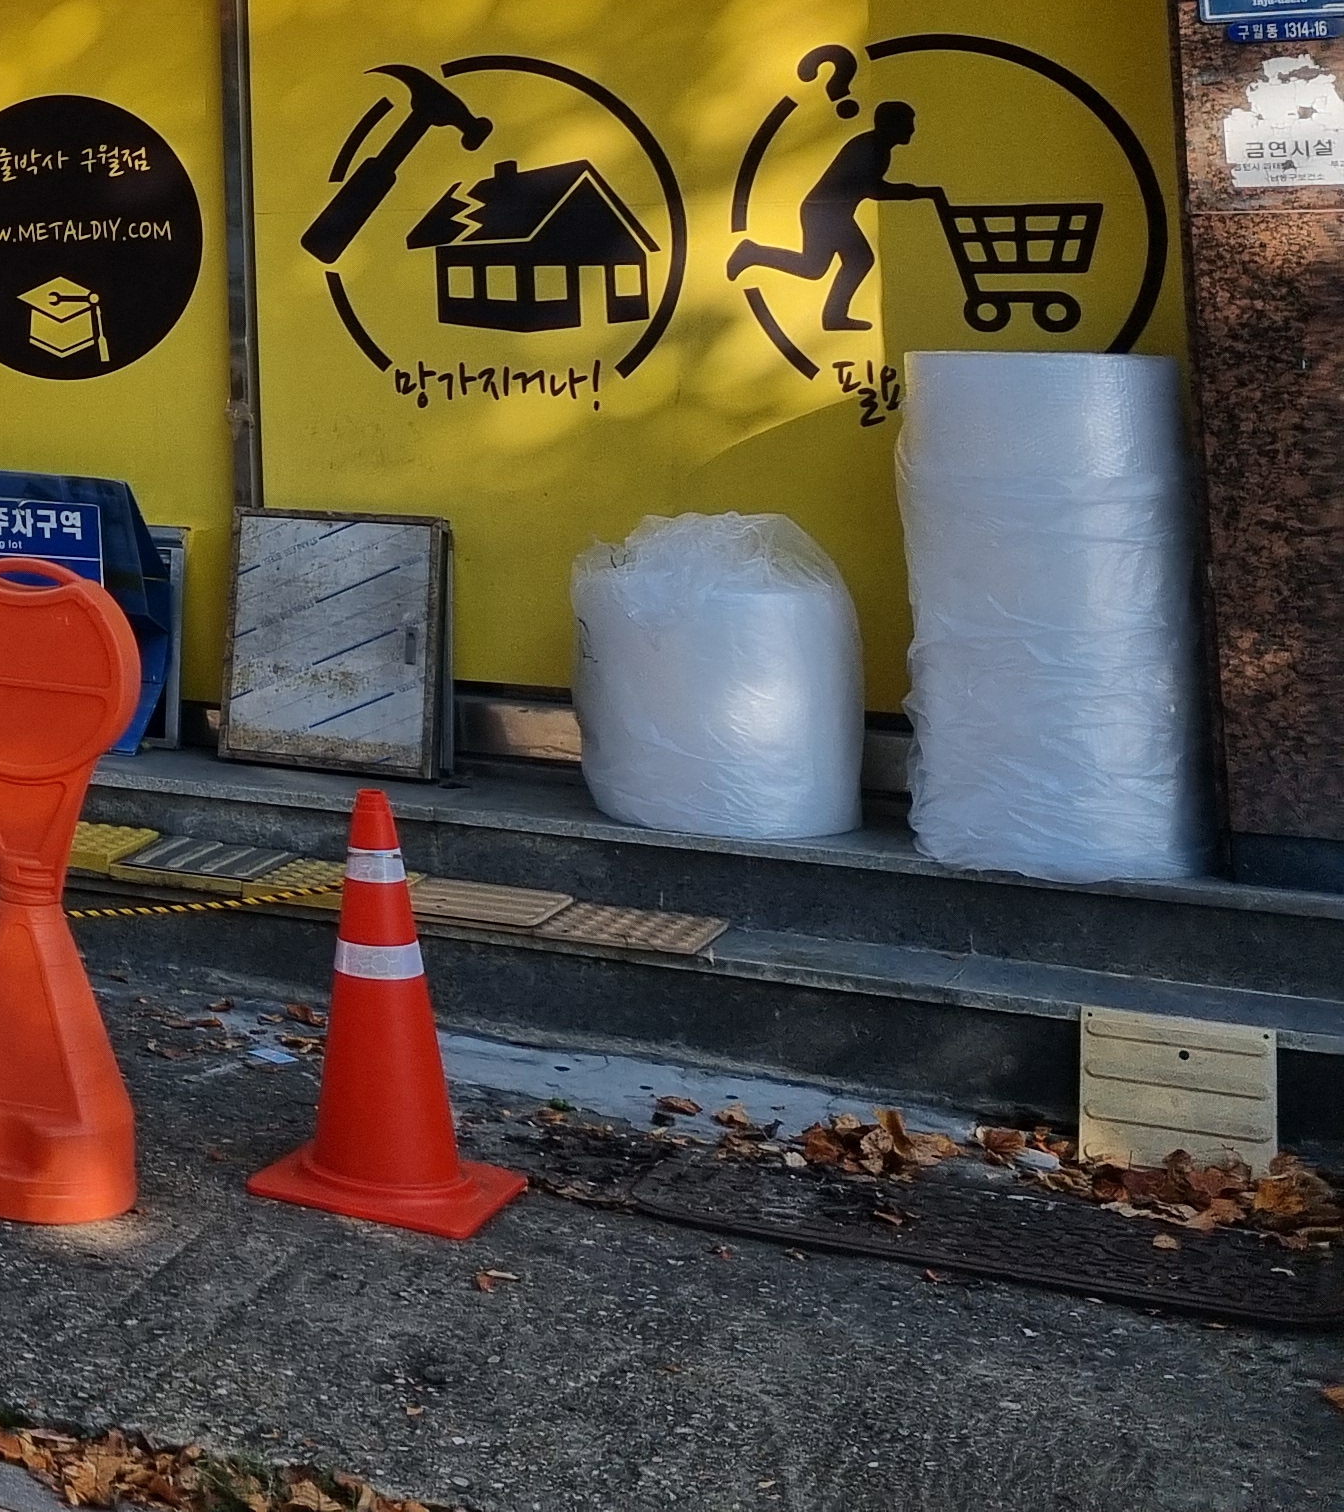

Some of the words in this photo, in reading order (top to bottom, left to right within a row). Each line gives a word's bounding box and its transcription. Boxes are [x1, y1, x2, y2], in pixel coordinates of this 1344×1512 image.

[1284, 20, 1328, 38] 1314-16
[1245, 139, 1333, 160] 금연시설
[80, 144, 151, 178] 구월점
[395, 359, 601, 412] 망가지거나!
[8, 539, 23, 550] lot
